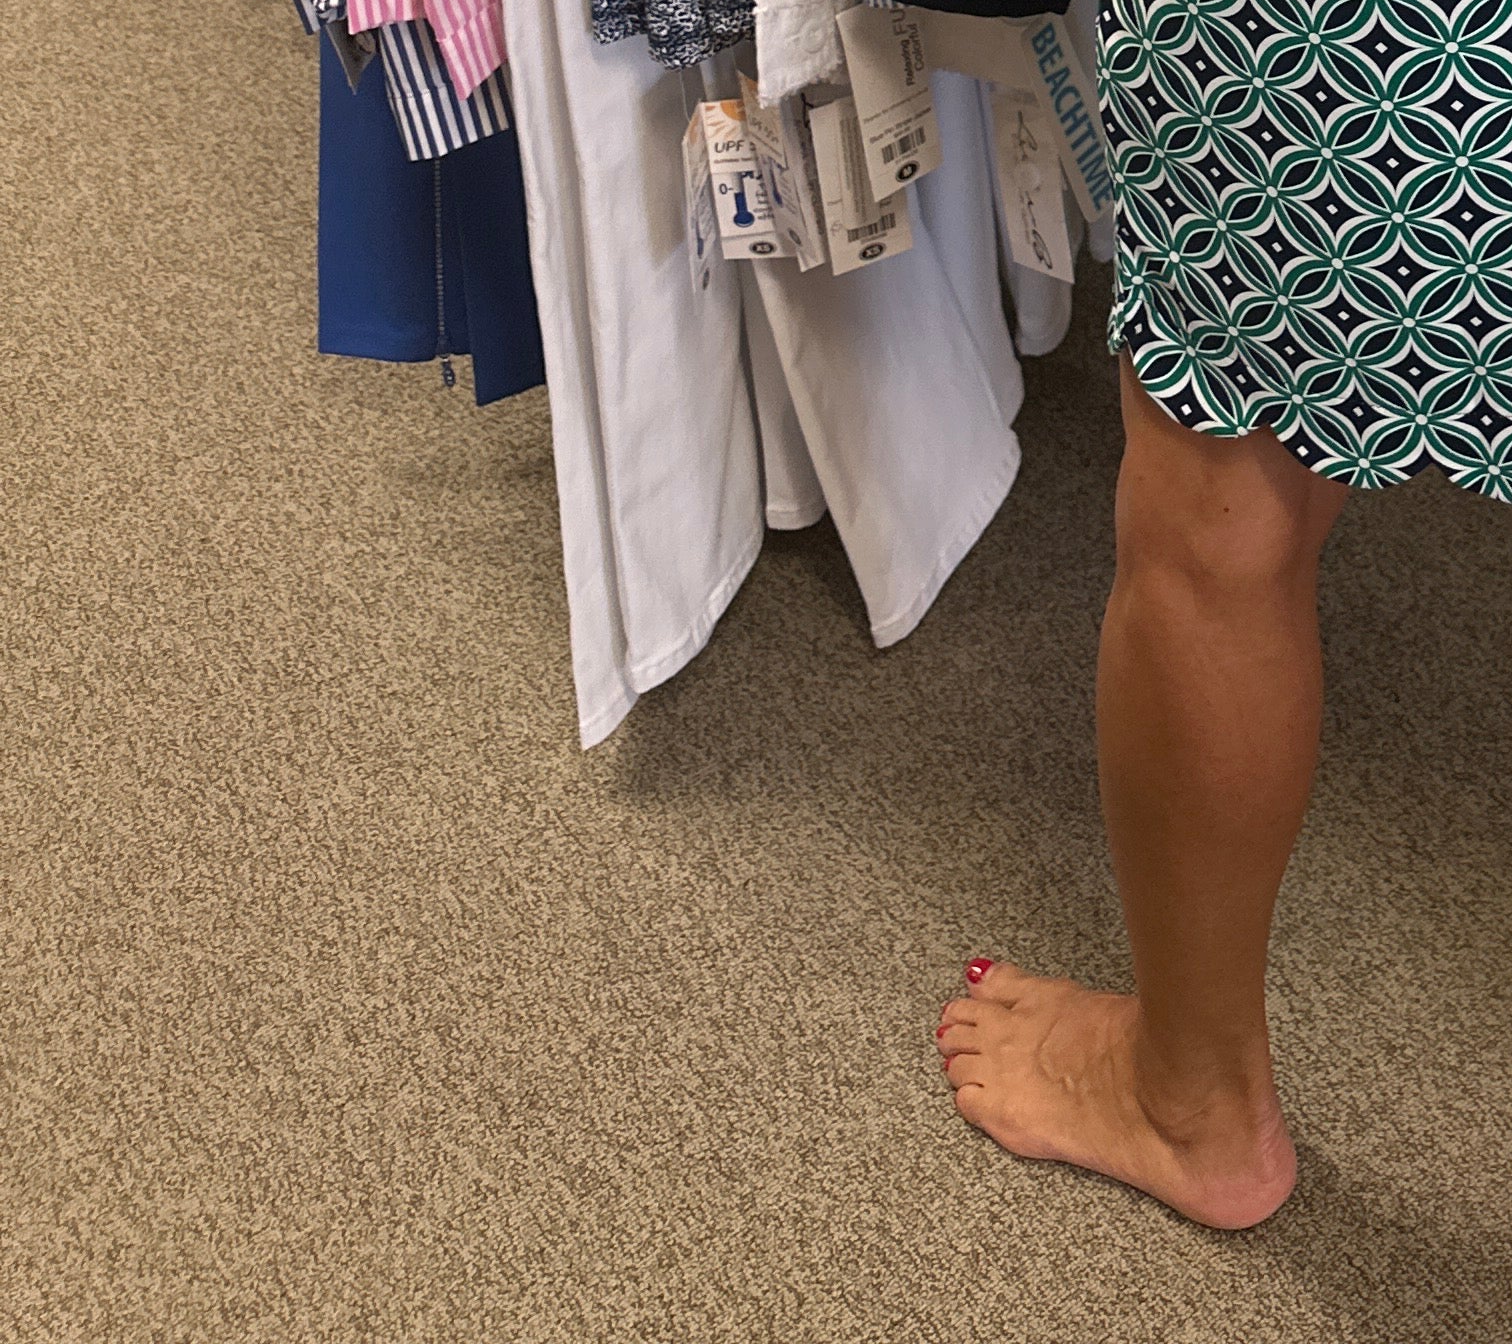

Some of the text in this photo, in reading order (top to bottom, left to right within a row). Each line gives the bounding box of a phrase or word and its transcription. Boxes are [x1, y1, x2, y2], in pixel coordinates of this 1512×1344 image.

[905, 23, 925, 72] Colorful
[1031, 22, 1112, 211] BEACHTIME
[714, 140, 744, 153] UPF
